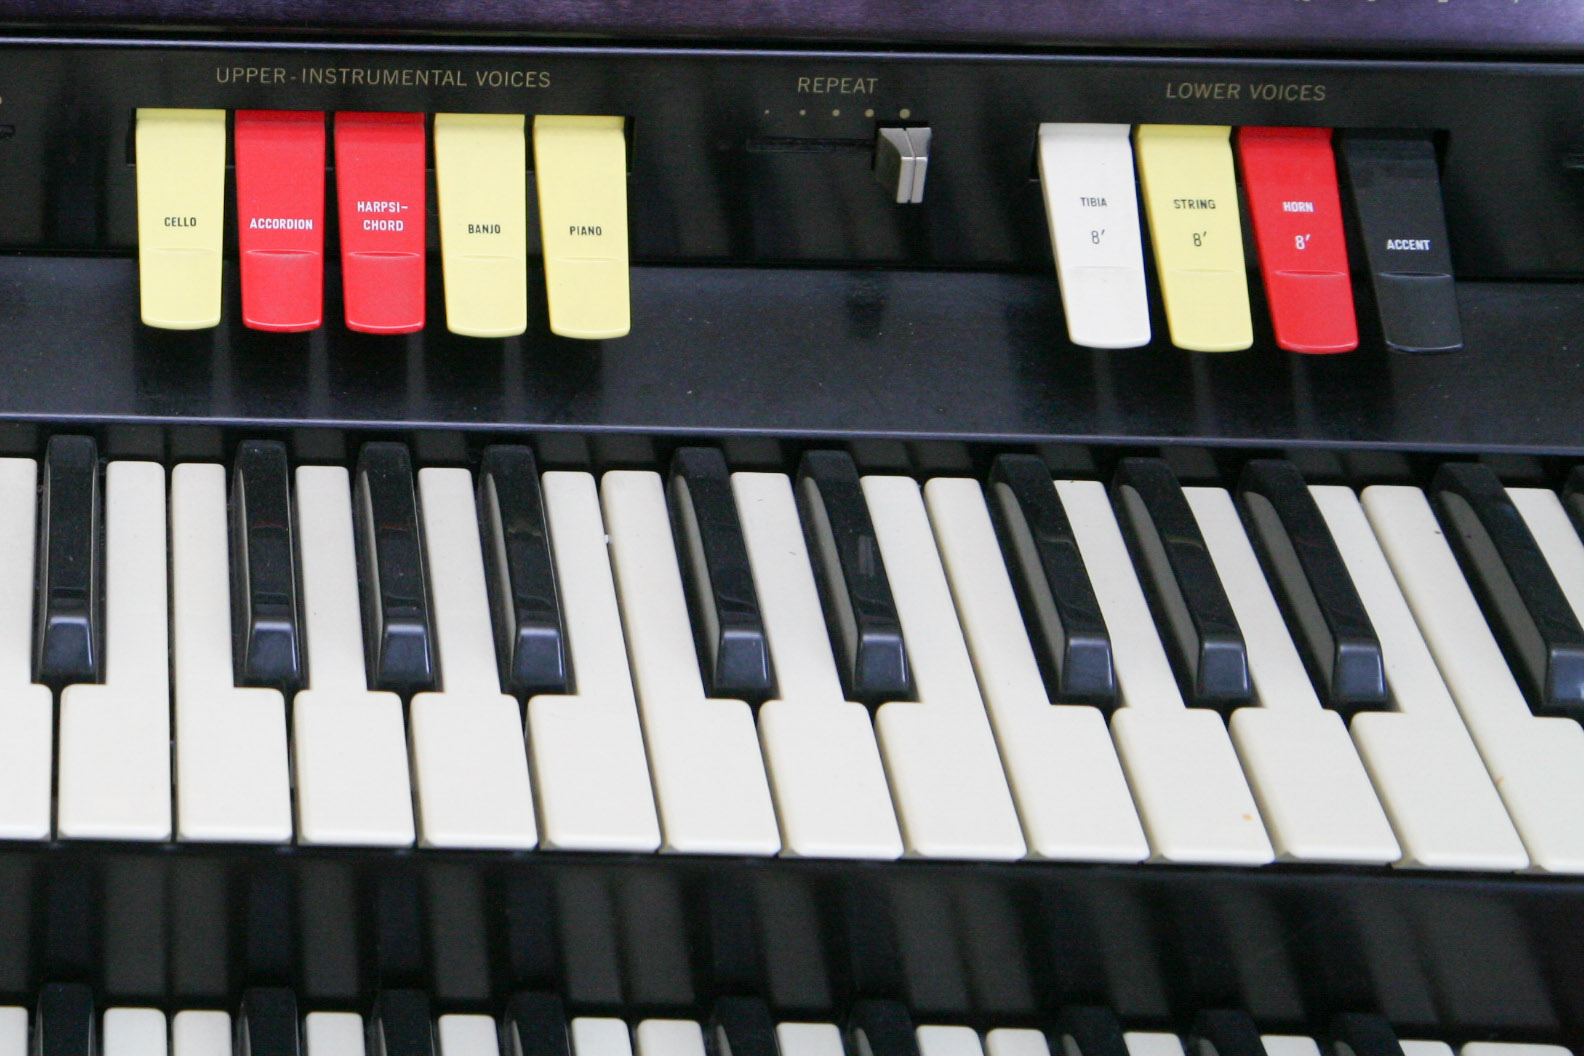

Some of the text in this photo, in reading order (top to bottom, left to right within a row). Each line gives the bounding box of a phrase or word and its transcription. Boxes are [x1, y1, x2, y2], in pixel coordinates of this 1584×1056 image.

[476, 71, 552, 89] VOICES
[797, 77, 879, 94] REPEAT
[1166, 82, 1327, 101] LOWER VOICES
[356, 201, 409, 213] HARPSI-
[1080, 196, 1108, 207] TIBIA
[1173, 198, 1217, 210] STRING
[1282, 201, 1314, 213] HORN
[163, 216, 197, 228] CELLO
[249, 217, 314, 230] ACCORDION
[363, 218, 405, 232] CHORD
[467, 223, 501, 235] BANJO
[569, 225, 603, 236] PIANO
[1386, 239, 1431, 251] ACCENT
